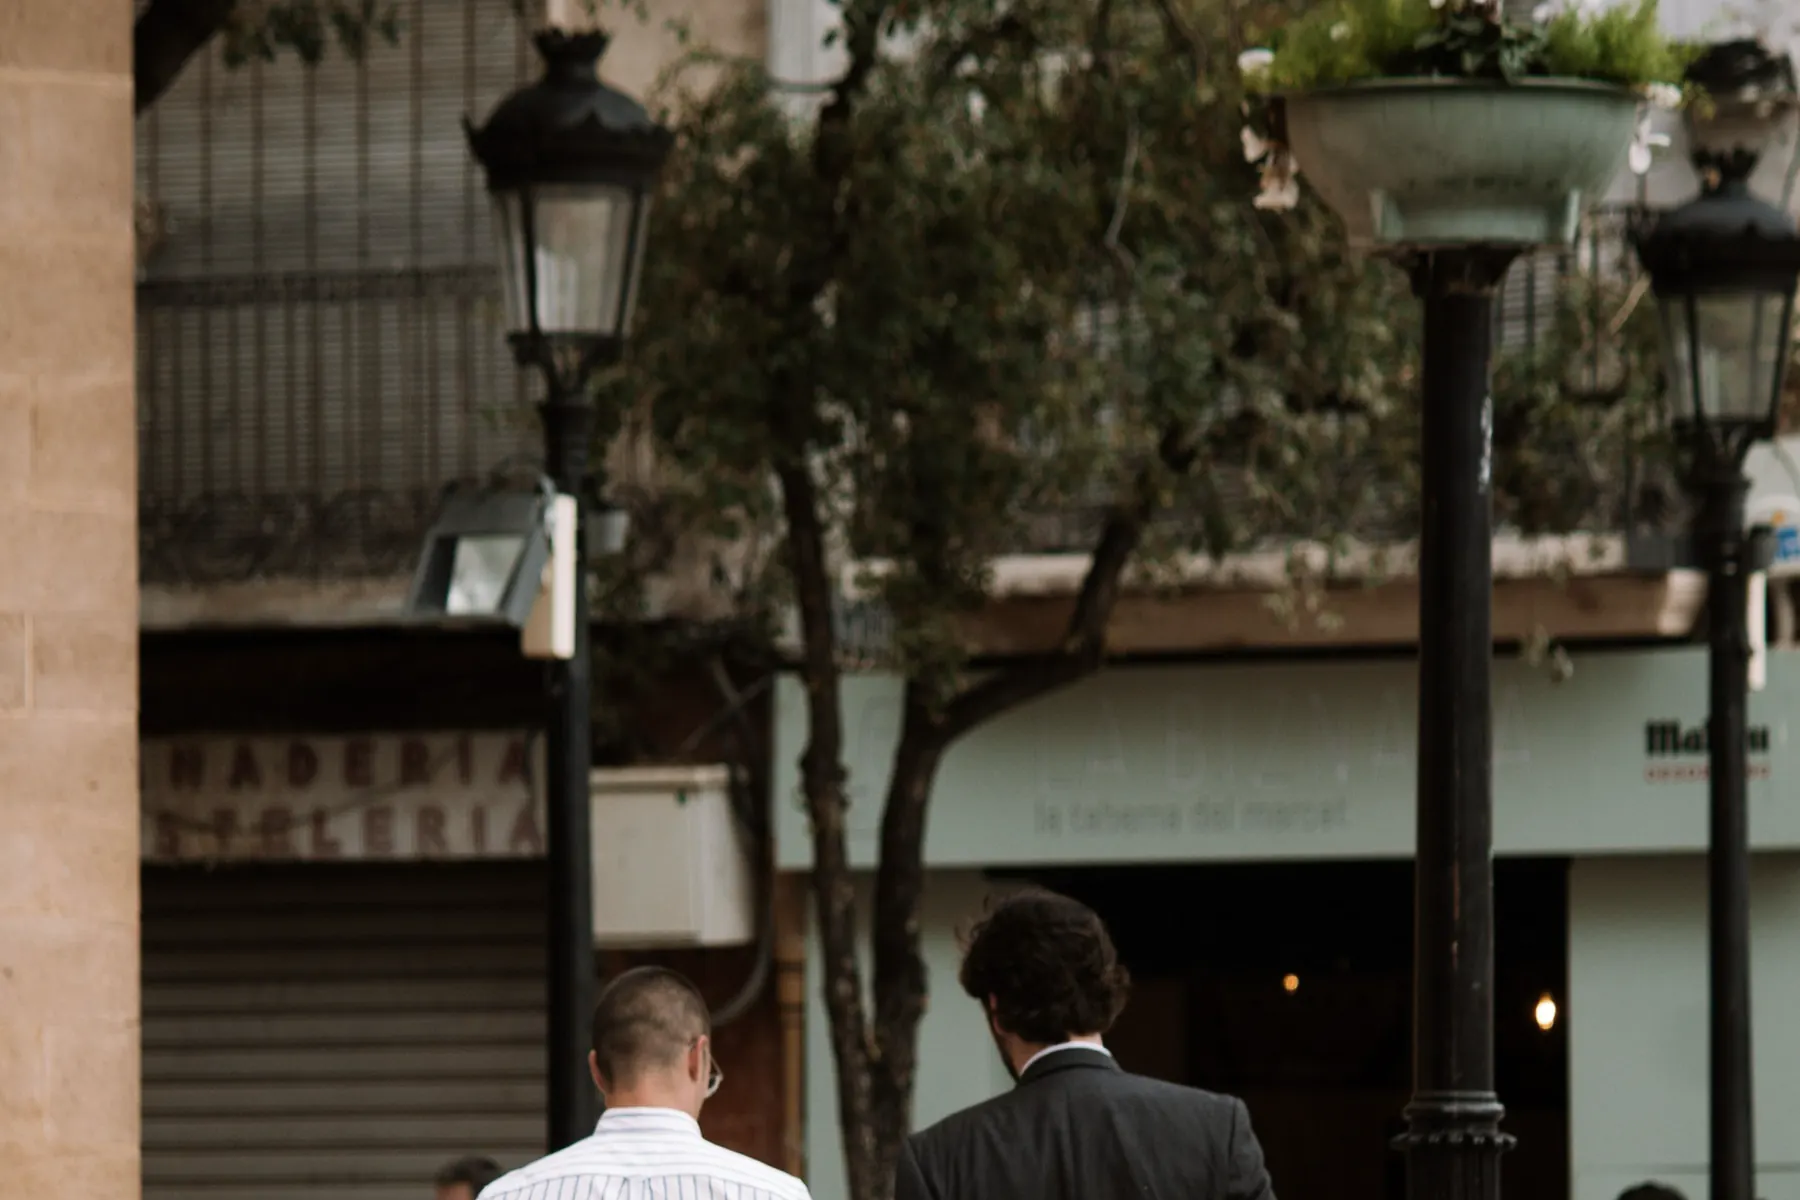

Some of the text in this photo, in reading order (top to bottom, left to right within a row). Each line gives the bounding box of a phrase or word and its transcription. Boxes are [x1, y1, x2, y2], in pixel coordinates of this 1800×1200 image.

[139, 736, 531, 789] NADERIA
[1165, 684, 1531, 791] BIZNAA
[1645, 719, 1770, 757] Mau
